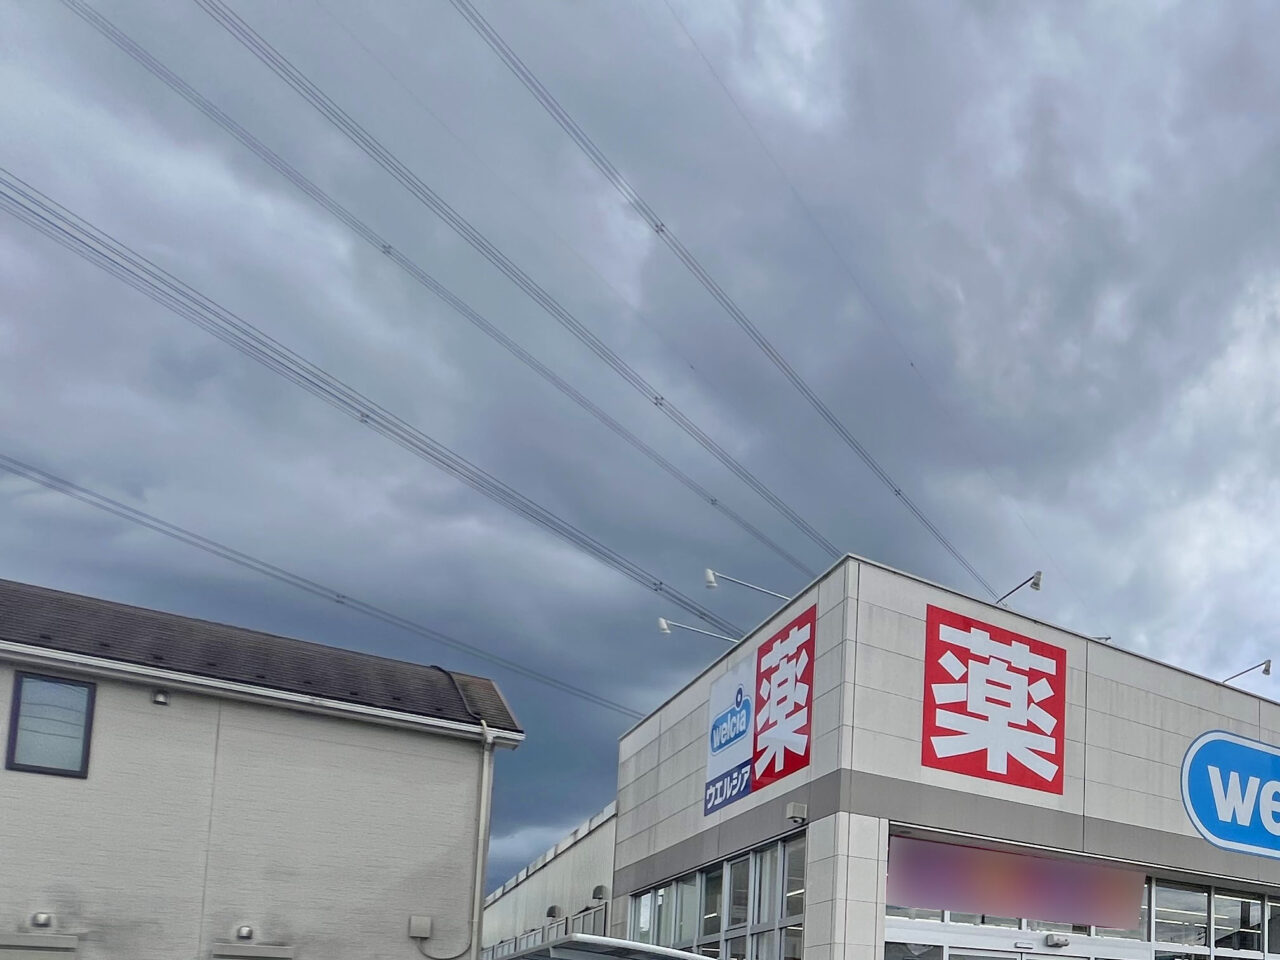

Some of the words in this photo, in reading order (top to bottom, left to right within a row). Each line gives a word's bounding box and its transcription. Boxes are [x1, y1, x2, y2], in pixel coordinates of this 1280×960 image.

[712, 706, 747, 749] welcia
[754, 623, 811, 780] 薬
[930, 623, 1059, 782] 薬
[706, 765, 751, 809] ウエルシア
